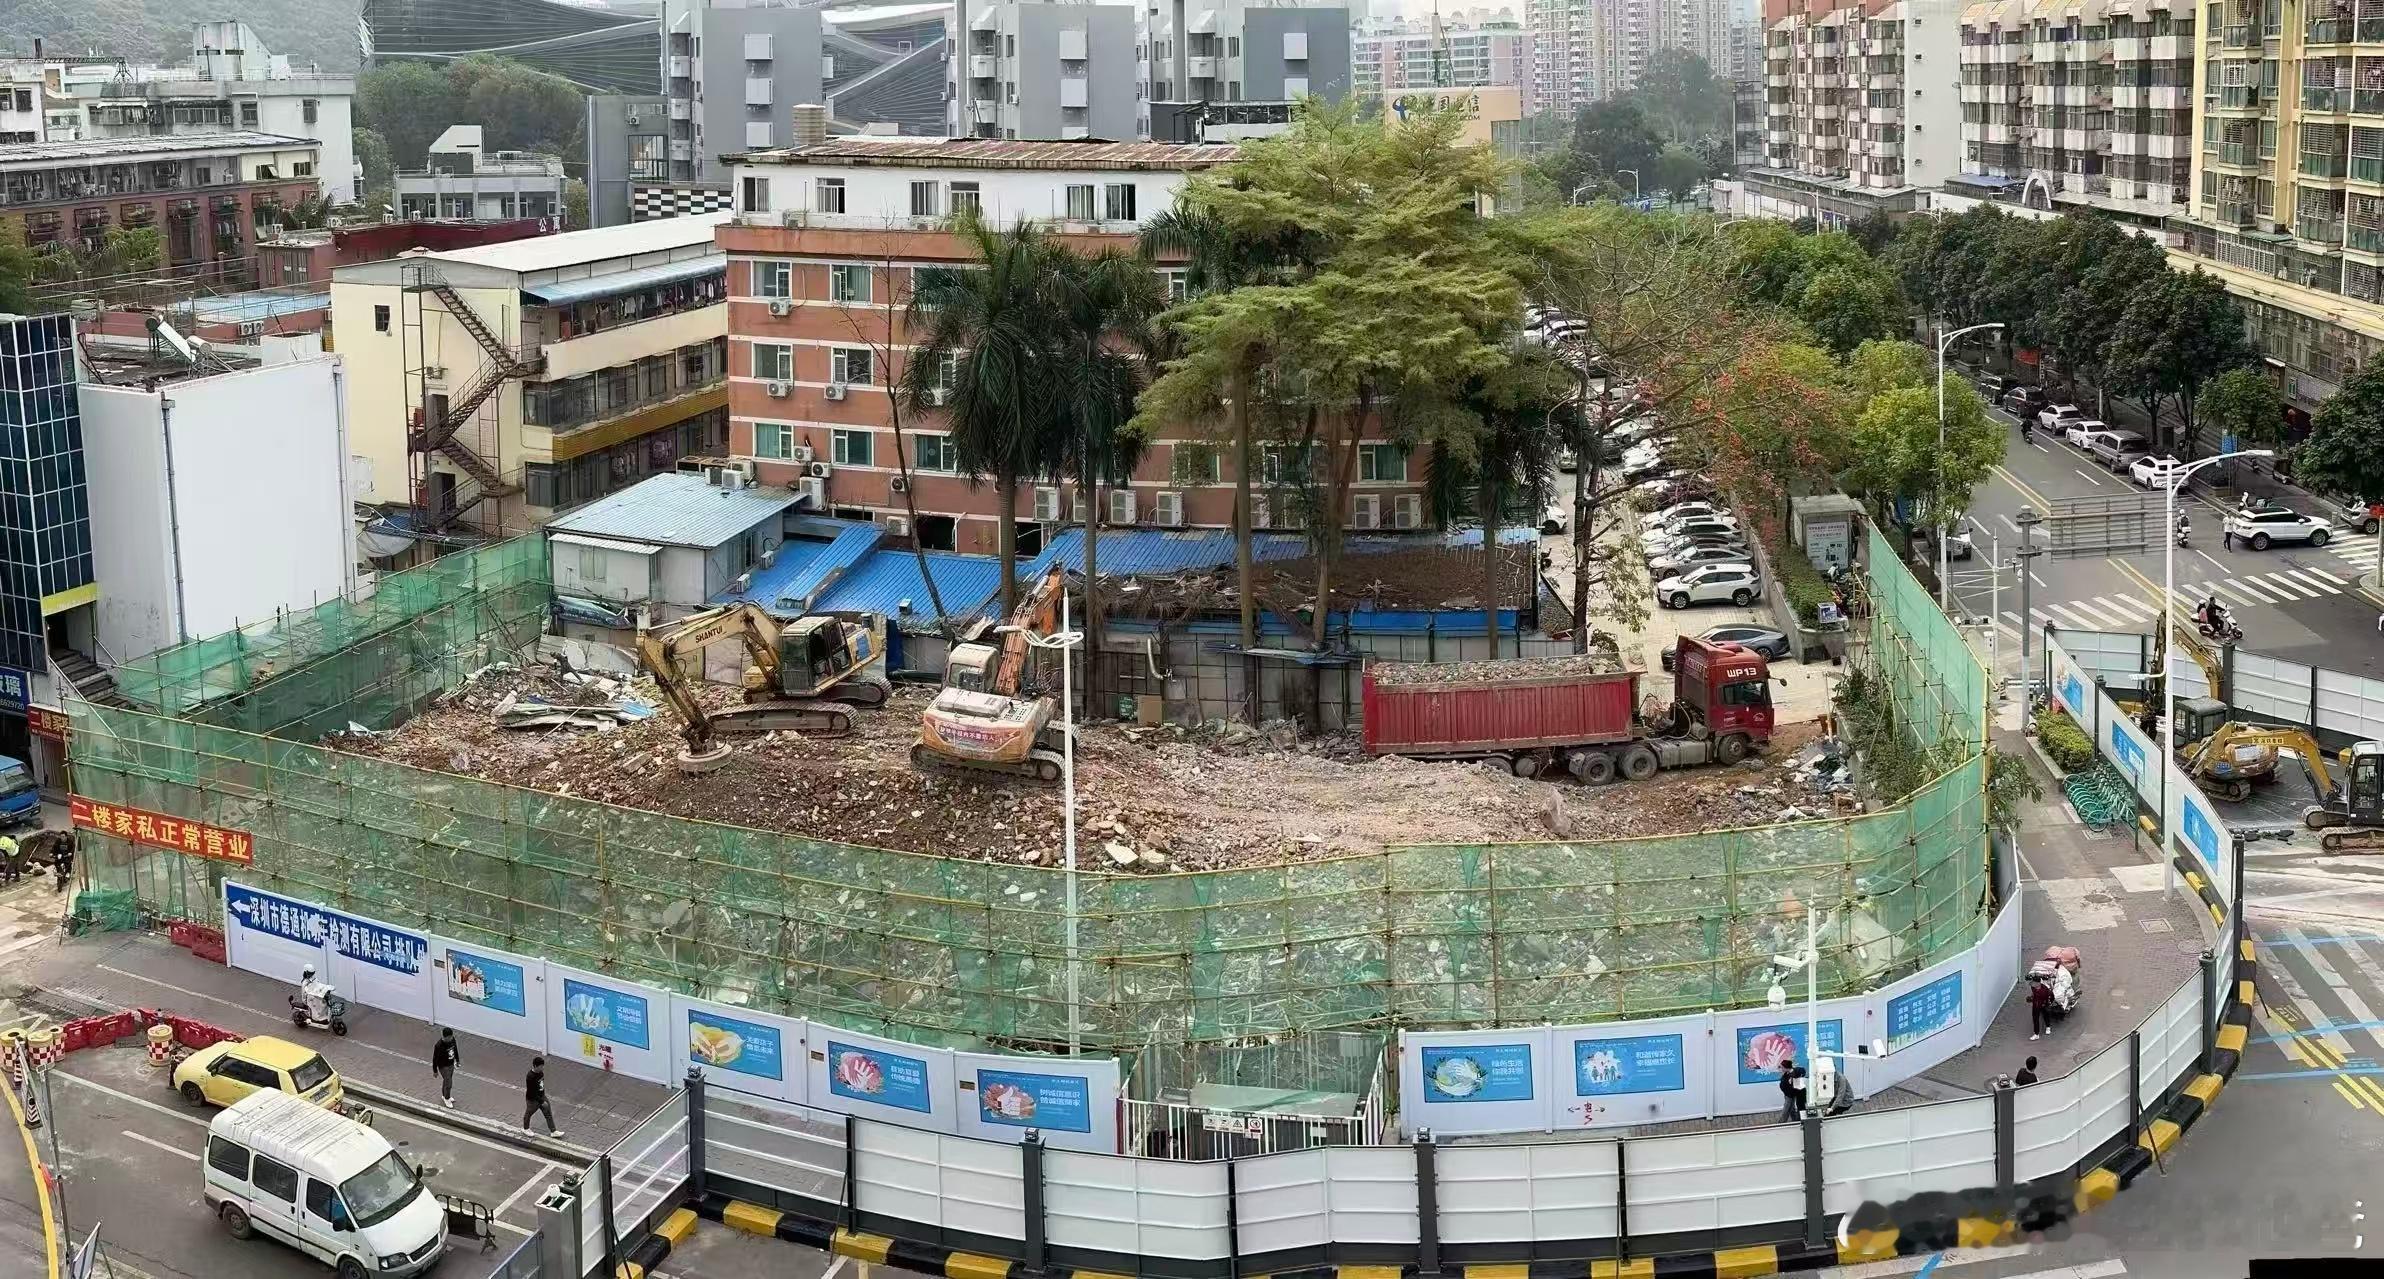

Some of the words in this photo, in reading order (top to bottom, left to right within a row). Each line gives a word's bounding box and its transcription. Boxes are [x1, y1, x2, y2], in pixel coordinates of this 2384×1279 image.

[695, 625, 723, 643] SHANTUI
[1727, 667, 1757, 678] WP13
[72, 801, 250, 860] 二楼家私正常营业
